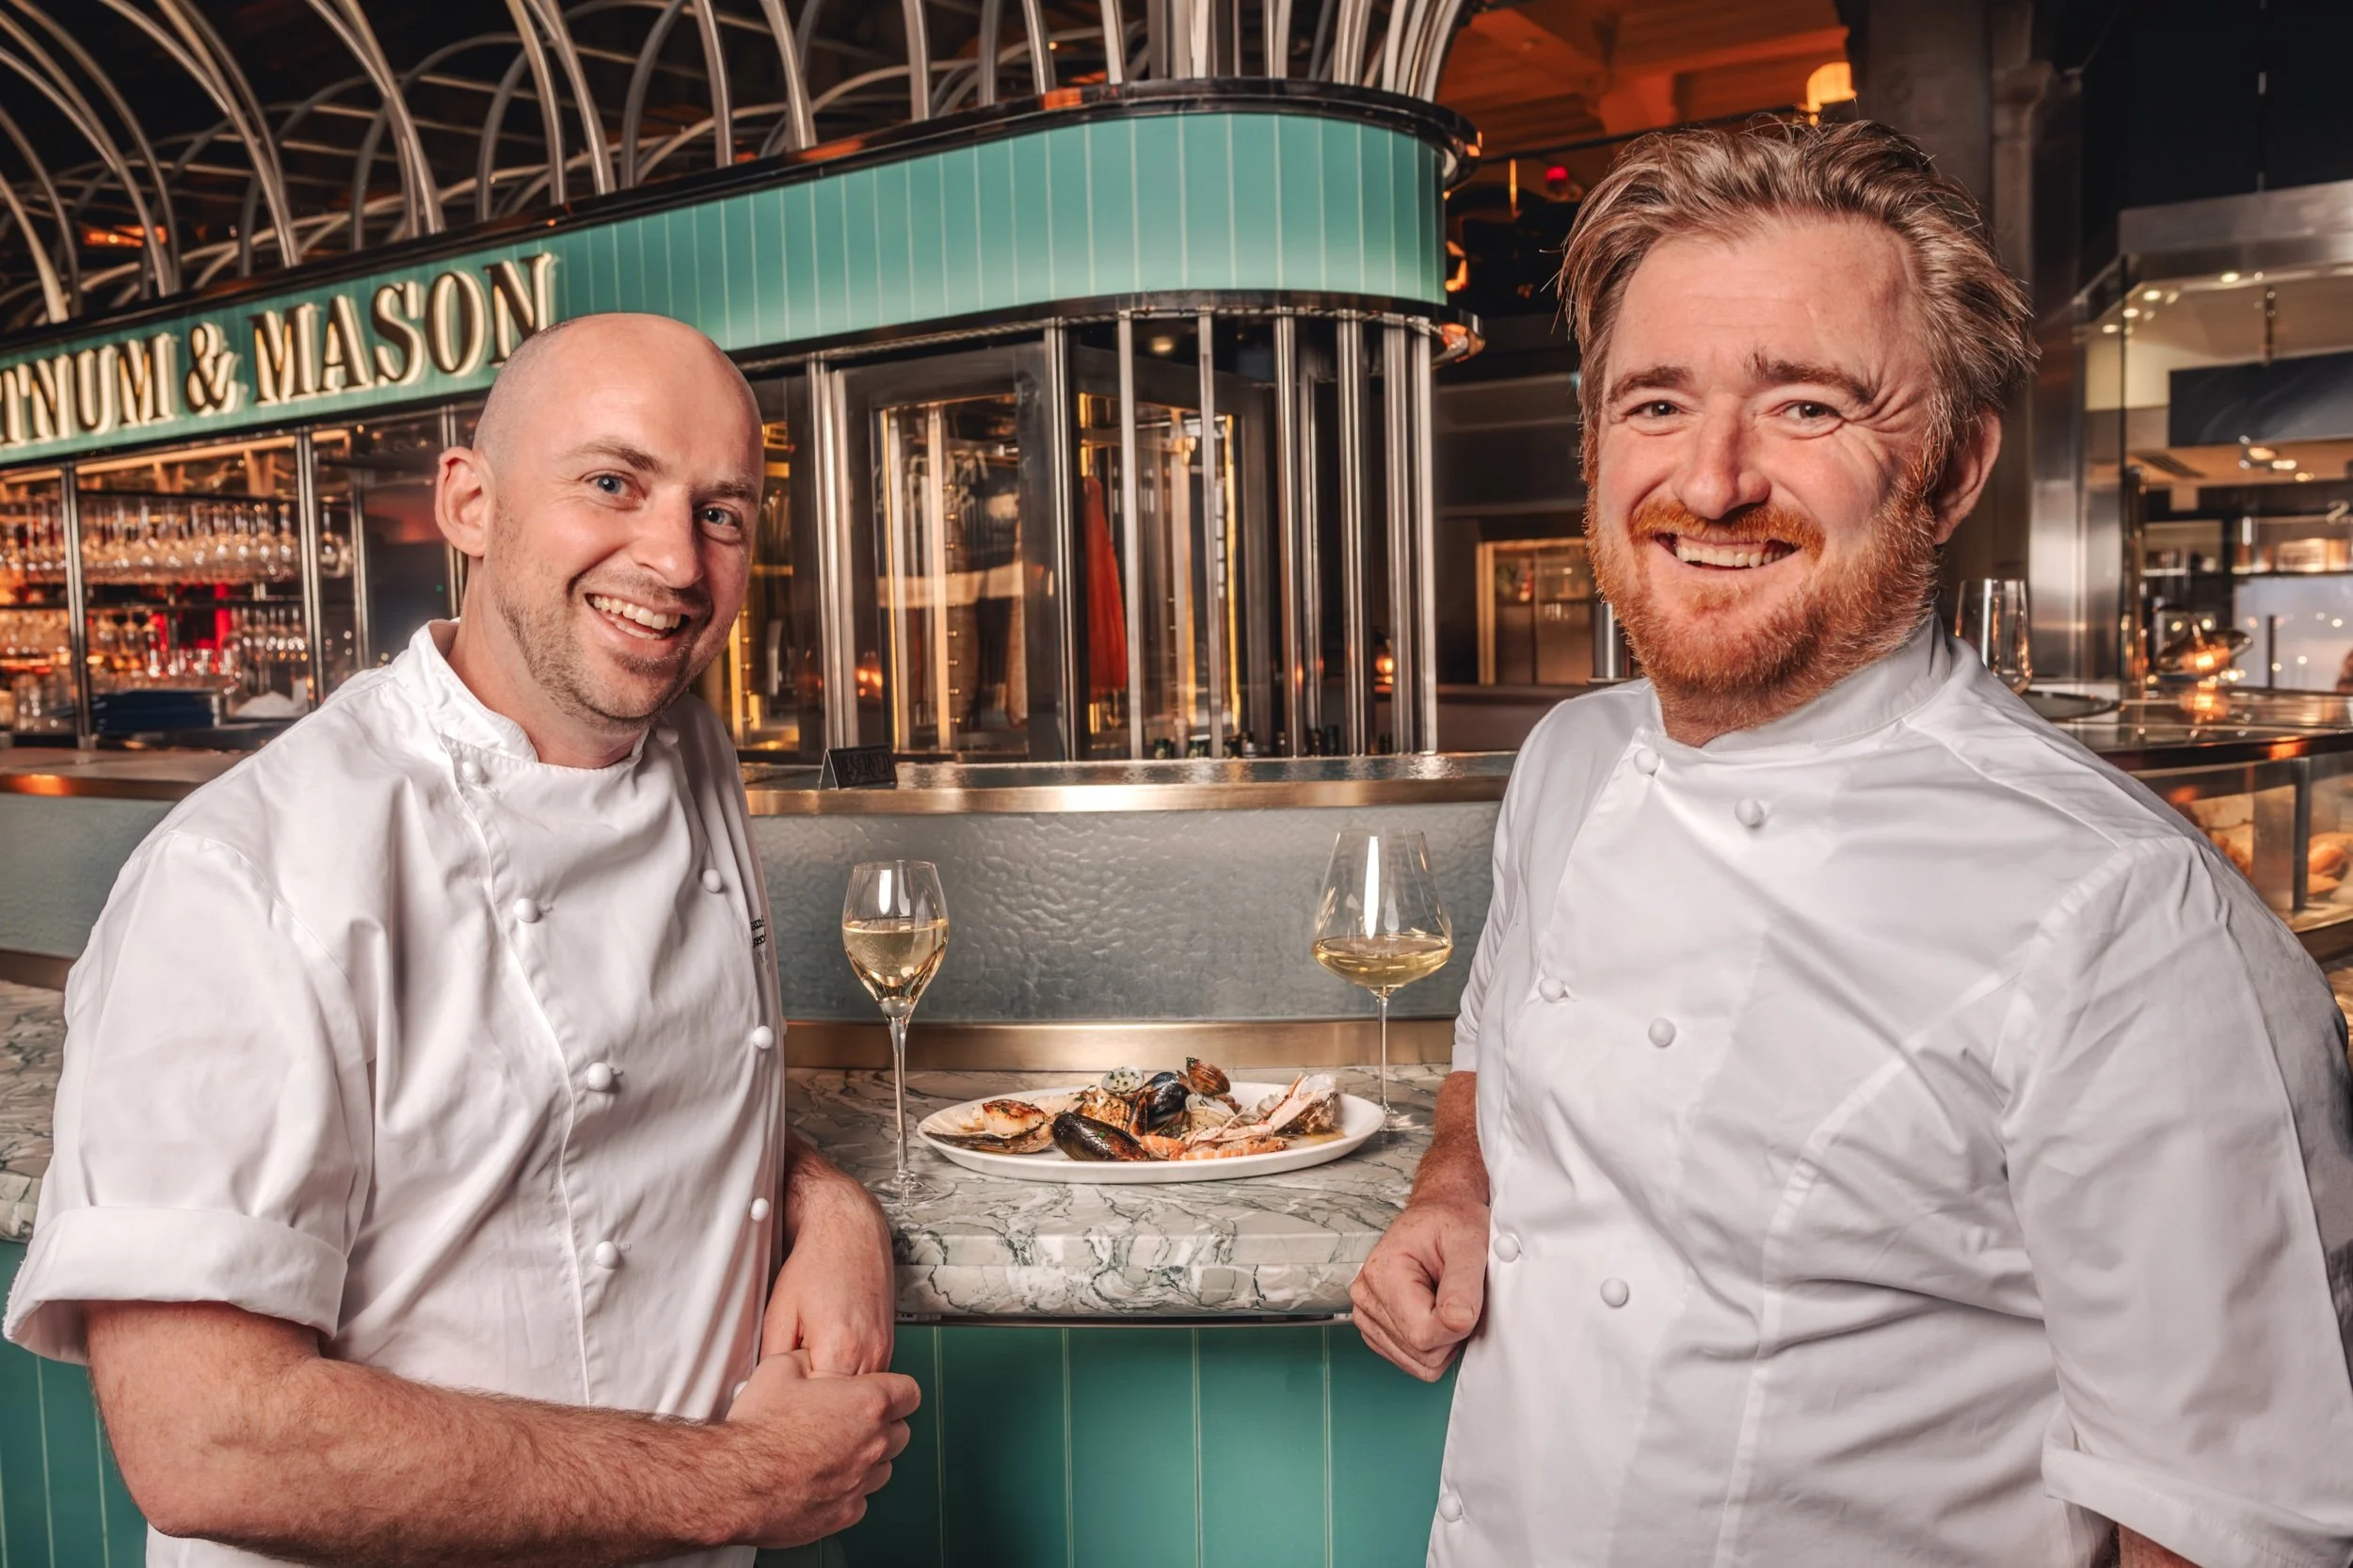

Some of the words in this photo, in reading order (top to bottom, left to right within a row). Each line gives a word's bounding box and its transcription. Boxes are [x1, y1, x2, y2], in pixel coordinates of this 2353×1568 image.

[0, 332, 179, 447] TNUM
[185, 322, 247, 417] &
[248, 252, 557, 407] MASON
